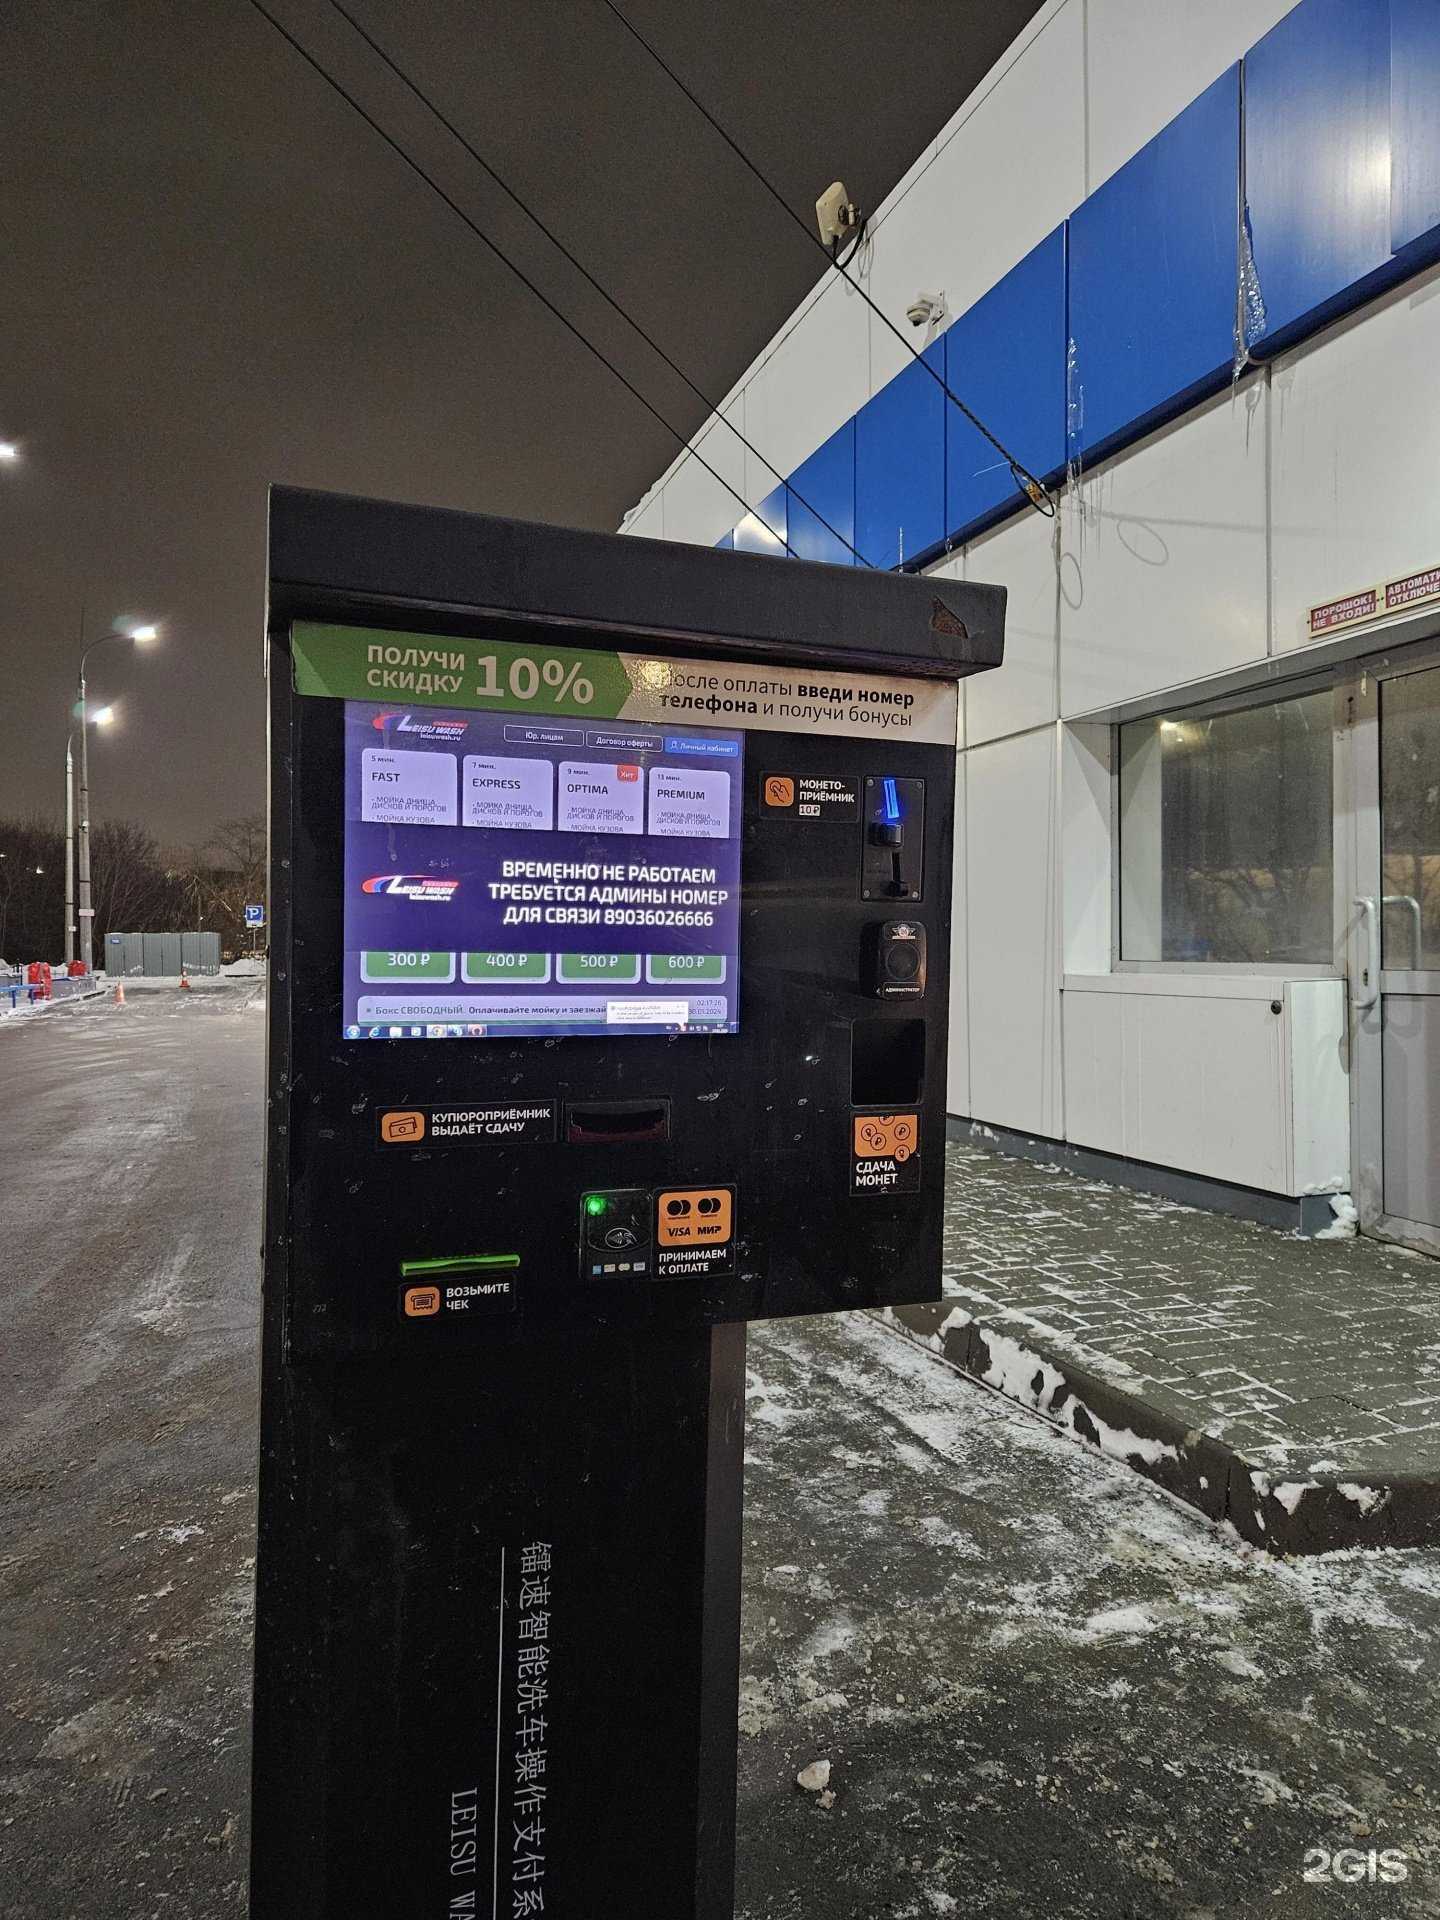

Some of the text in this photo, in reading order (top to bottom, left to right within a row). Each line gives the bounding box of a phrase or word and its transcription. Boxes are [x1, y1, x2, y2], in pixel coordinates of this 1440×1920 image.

[1314, 594, 1372, 619] ПОРОШОК!
[1313, 603, 1375, 628] НЕ ВХОДИ!
[367, 645, 465, 671] ПОЛУЧИ
[366, 669, 463, 695] СКИДКУ
[476, 655, 594, 704] 10%
[723, 676, 793, 697] оплаты
[797, 684, 853, 702] введи
[857, 689, 914, 710] номер
[659, 692, 912, 727] телефона и получи бонусы
[525, 731, 564, 742] Юр. лицам
[596, 736, 653, 748] Договор оферты
[371, 772, 400, 783] FAST
[621, 770, 634, 779] Хит
[472, 778, 521, 790] EXPRESS
[567, 784, 608, 795] OPTIMA
[799, 779, 845, 790] МОНЕТО-
[657, 789, 705, 800] PREMIUM
[799, 790, 855, 803] ПРИЁМНИК
[502, 861, 716, 884] ВРЕМЕННО НЕ РАБОТАЕМ
[488, 882, 729, 905] ТРЕБУЕТСЯ АДМИНЫ НОМЕР
[249, 908, 259, 919] P
[503, 906, 713, 927] ДЛЯ СВЯЗИ 89036026666
[388, 952, 417, 966] 300
[486, 953, 515, 967] 400
[580, 955, 608, 968] 500
[668, 955, 694, 968] 600
[375, 1006, 399, 1015] Бокс
[469, 1006, 530, 1016] Оплачивайте
[533, 1006, 559, 1017] мойку
[561, 1007, 568, 1015] и
[431, 1108, 551, 1123] КУПЮРОПРИЁМНИК
[431, 1121, 526, 1137] ВЫДАЁТ СДАЧУ
[855, 1160, 896, 1175] СДАЧА
[855, 1173, 898, 1187] МОНЕТ
[668, 1226, 690, 1237] VISA
[698, 1225, 722, 1235] МИР
[658, 1248, 727, 1263] ПРИНИМАЕМ
[658, 1265, 666, 1275] К
[668, 1262, 709, 1275] ОПЛАТЕ
[446, 1282, 510, 1298] ВОЗЬМИТЕ
[446, 1300, 469, 1310] ЧЕК
[450, 1787, 478, 1876] LEISU
